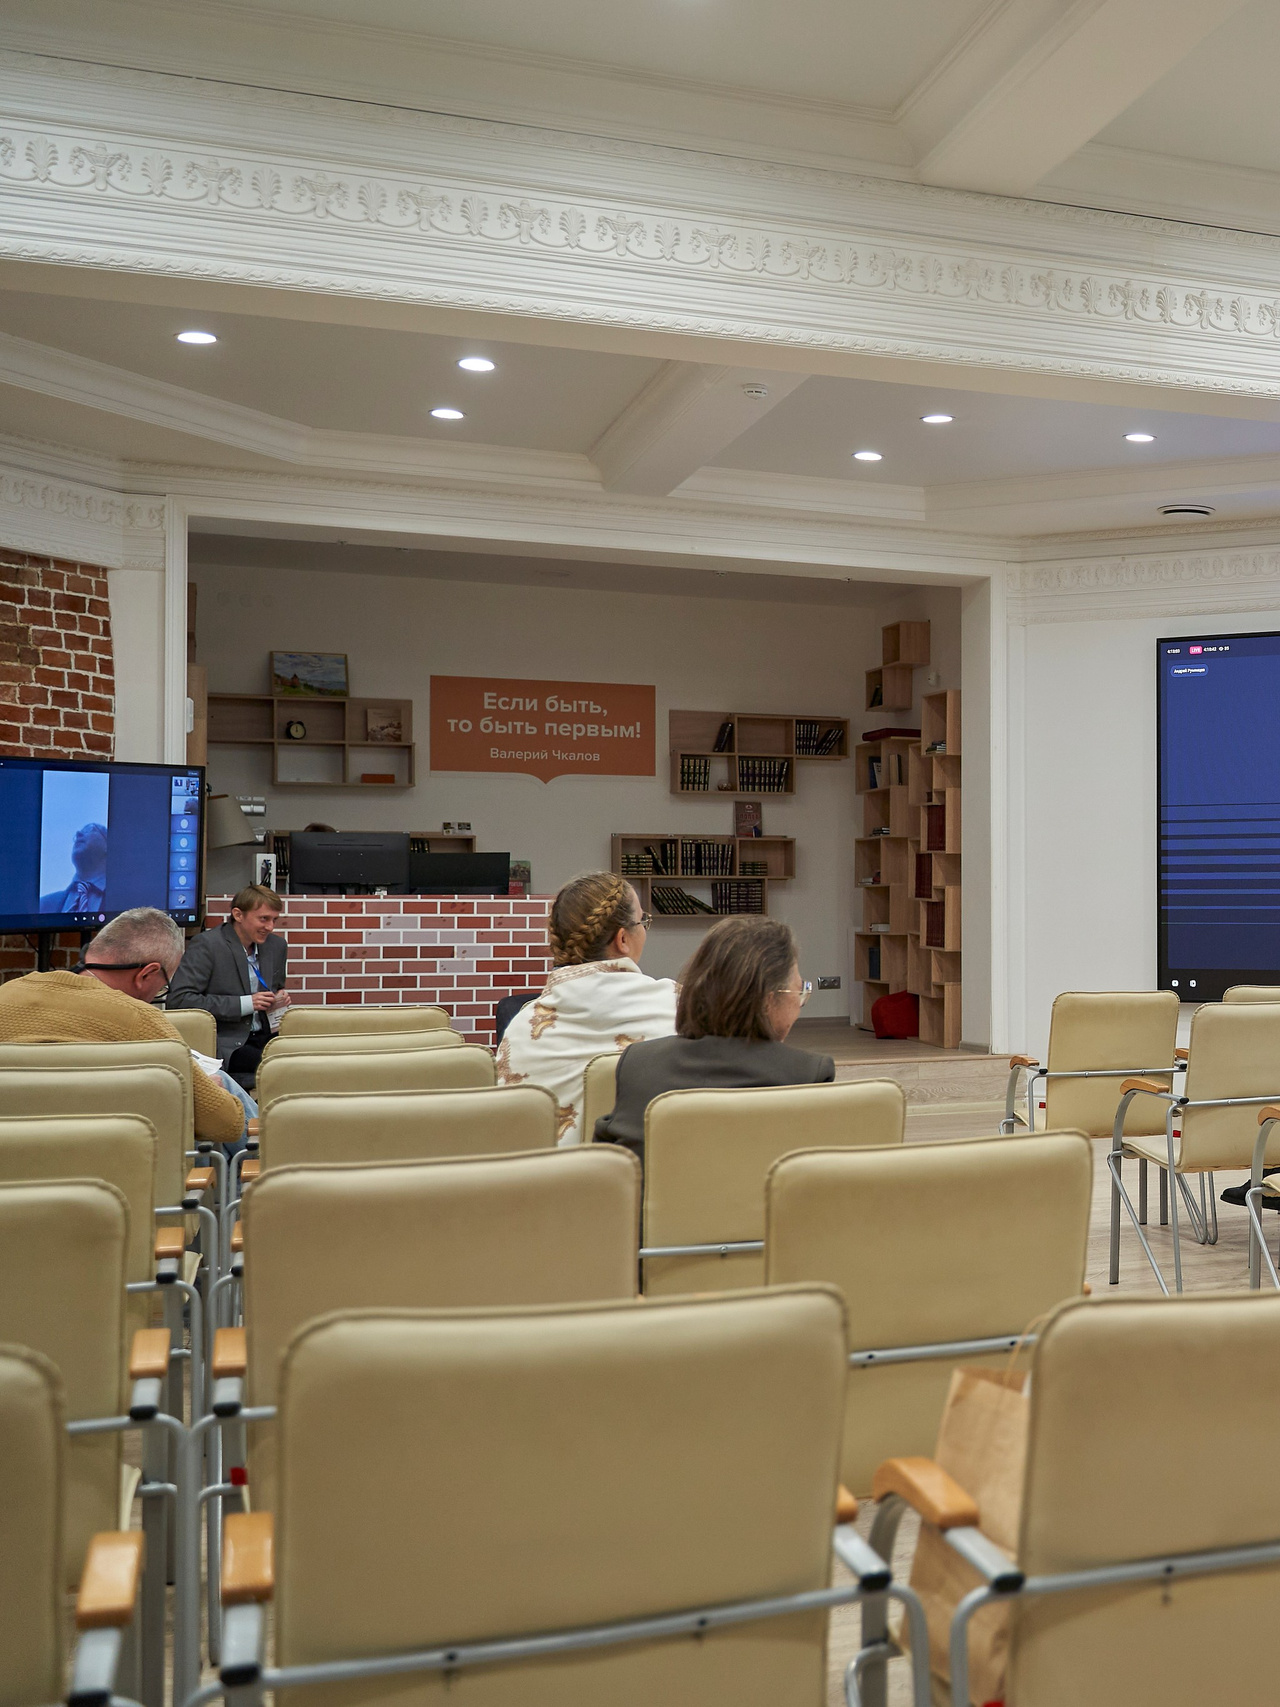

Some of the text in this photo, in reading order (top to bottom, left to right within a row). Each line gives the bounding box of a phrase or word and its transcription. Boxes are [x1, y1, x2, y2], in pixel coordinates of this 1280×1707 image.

[483, 691, 608, 717] Если быть,
[447, 716, 641, 741] то быть первым!
[489, 747, 601, 762] Валерий Чкалов
